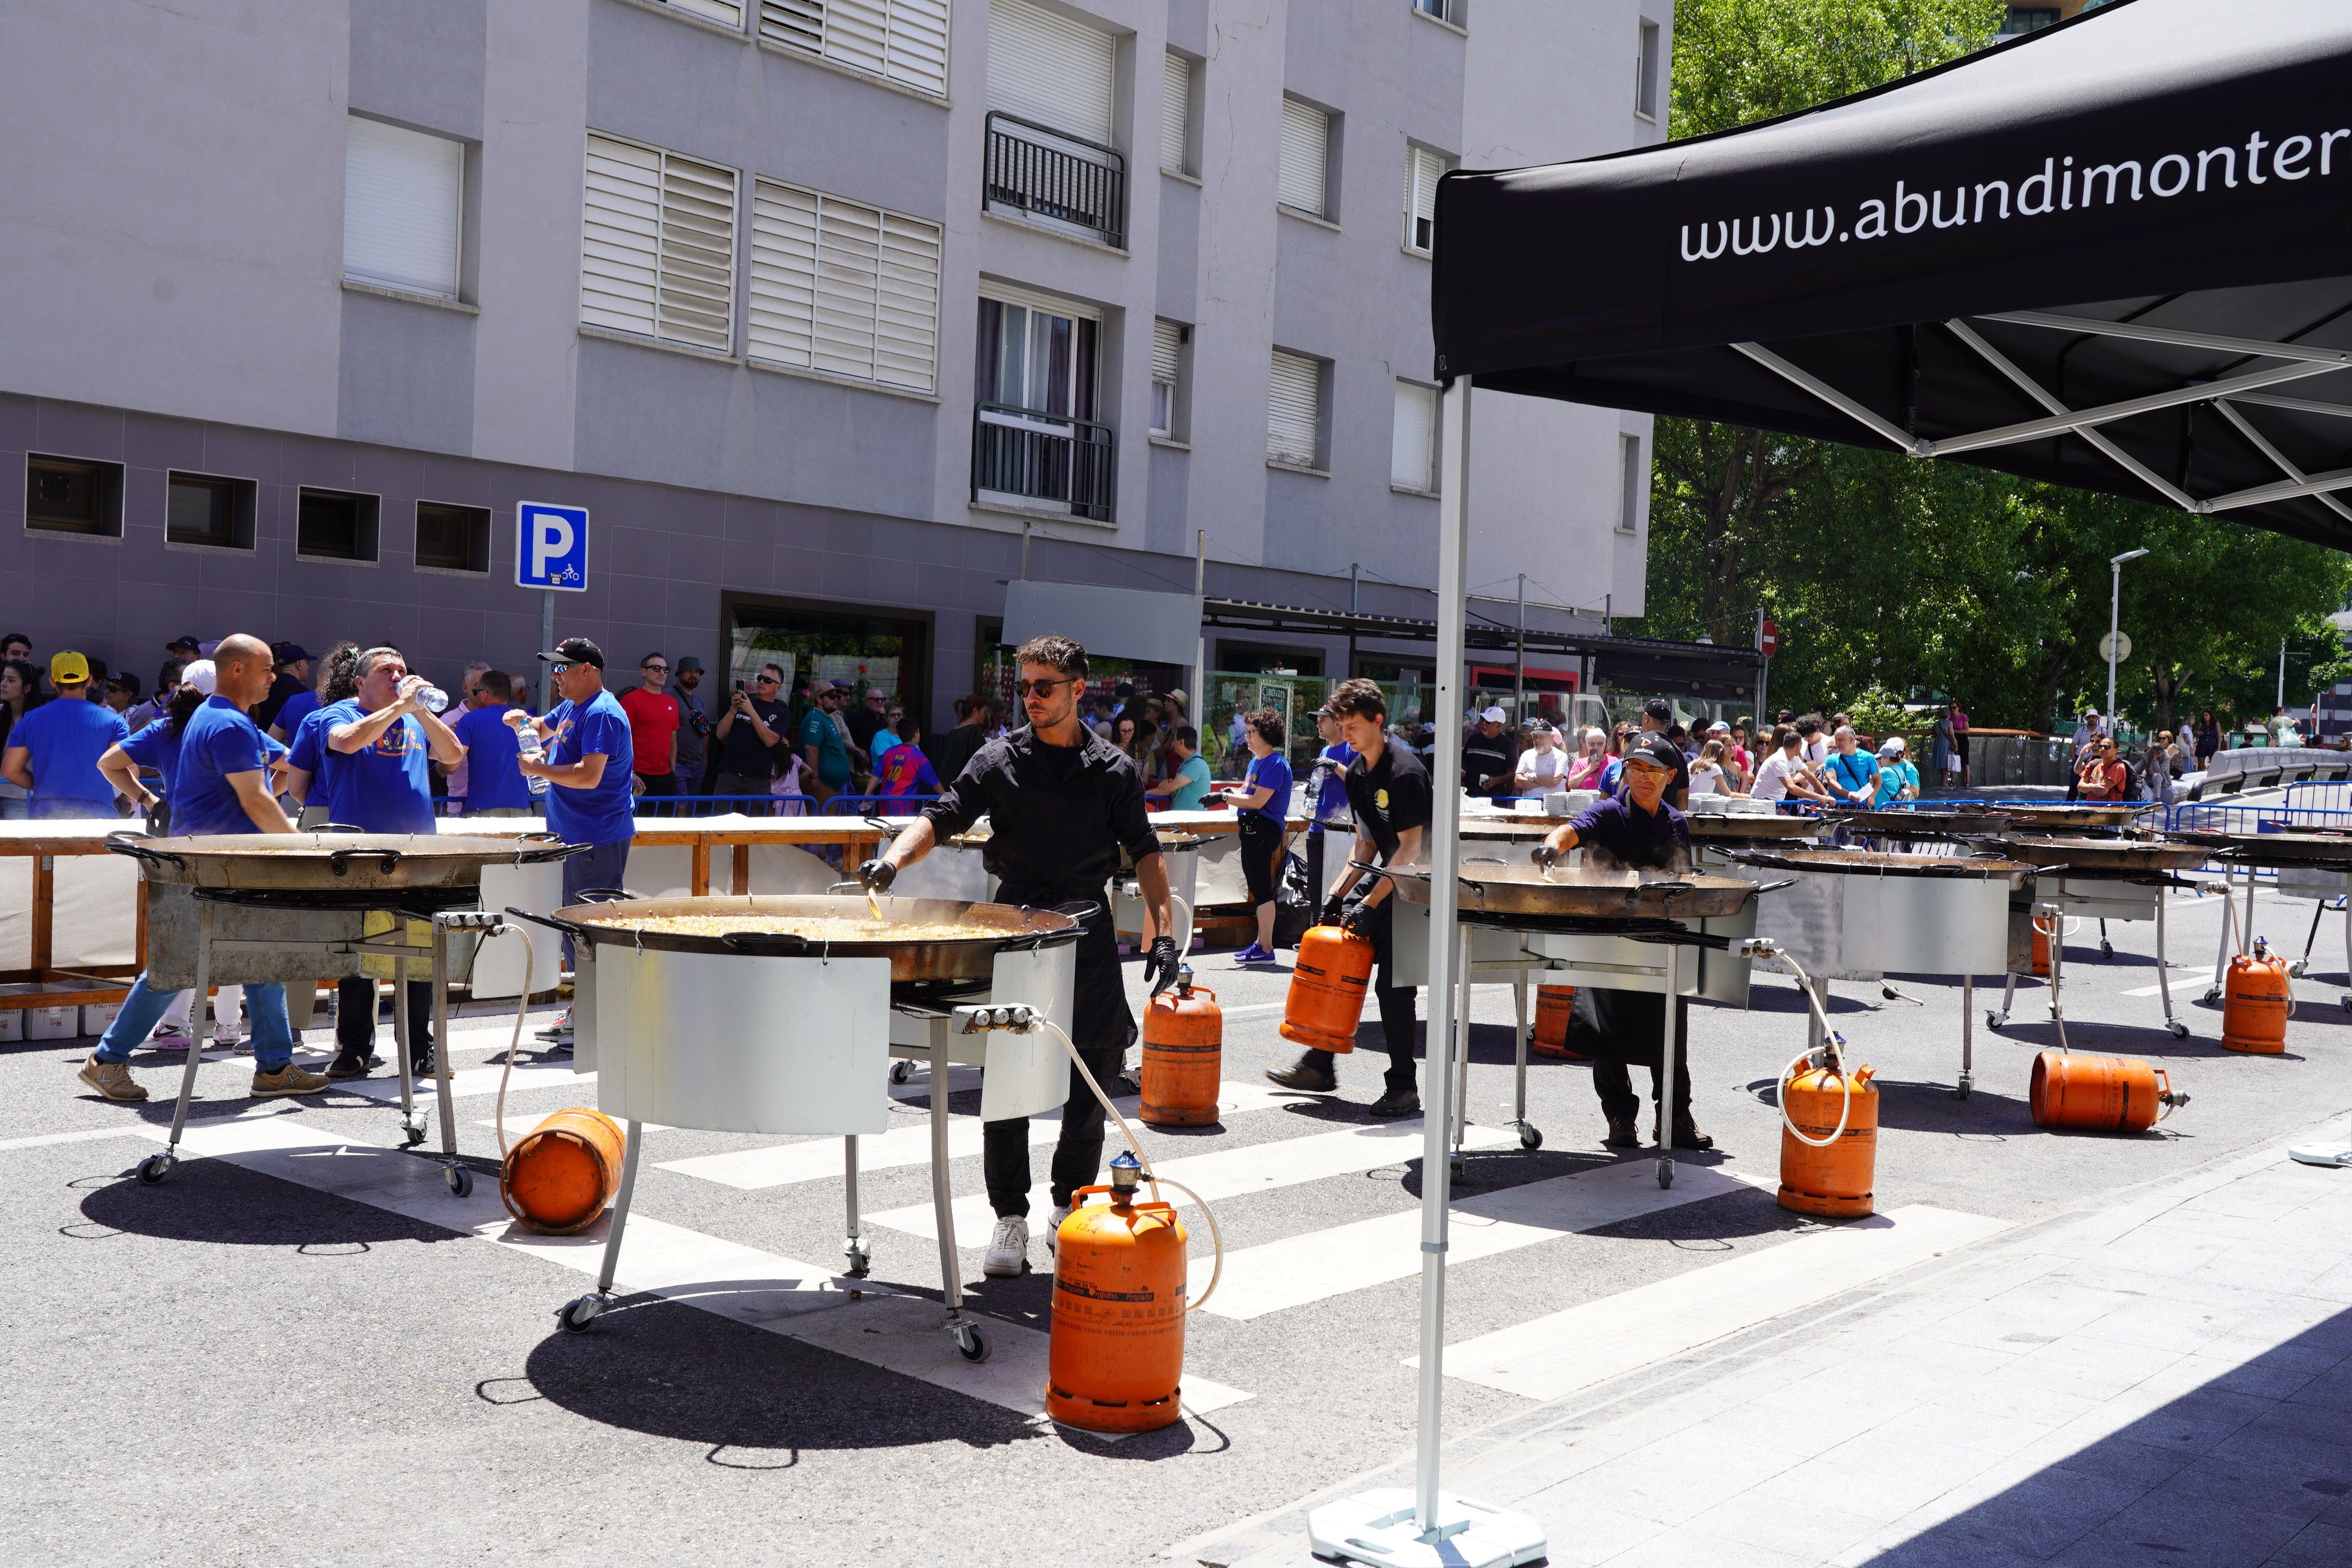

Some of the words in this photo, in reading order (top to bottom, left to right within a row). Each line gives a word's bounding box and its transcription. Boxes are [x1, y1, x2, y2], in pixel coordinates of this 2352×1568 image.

[1681, 128, 2351, 262] www.abundimonter
[532, 513, 574, 578] P
[1064, 1284, 1085, 1295] Propano
[1095, 1291, 1118, 1300] ropano
